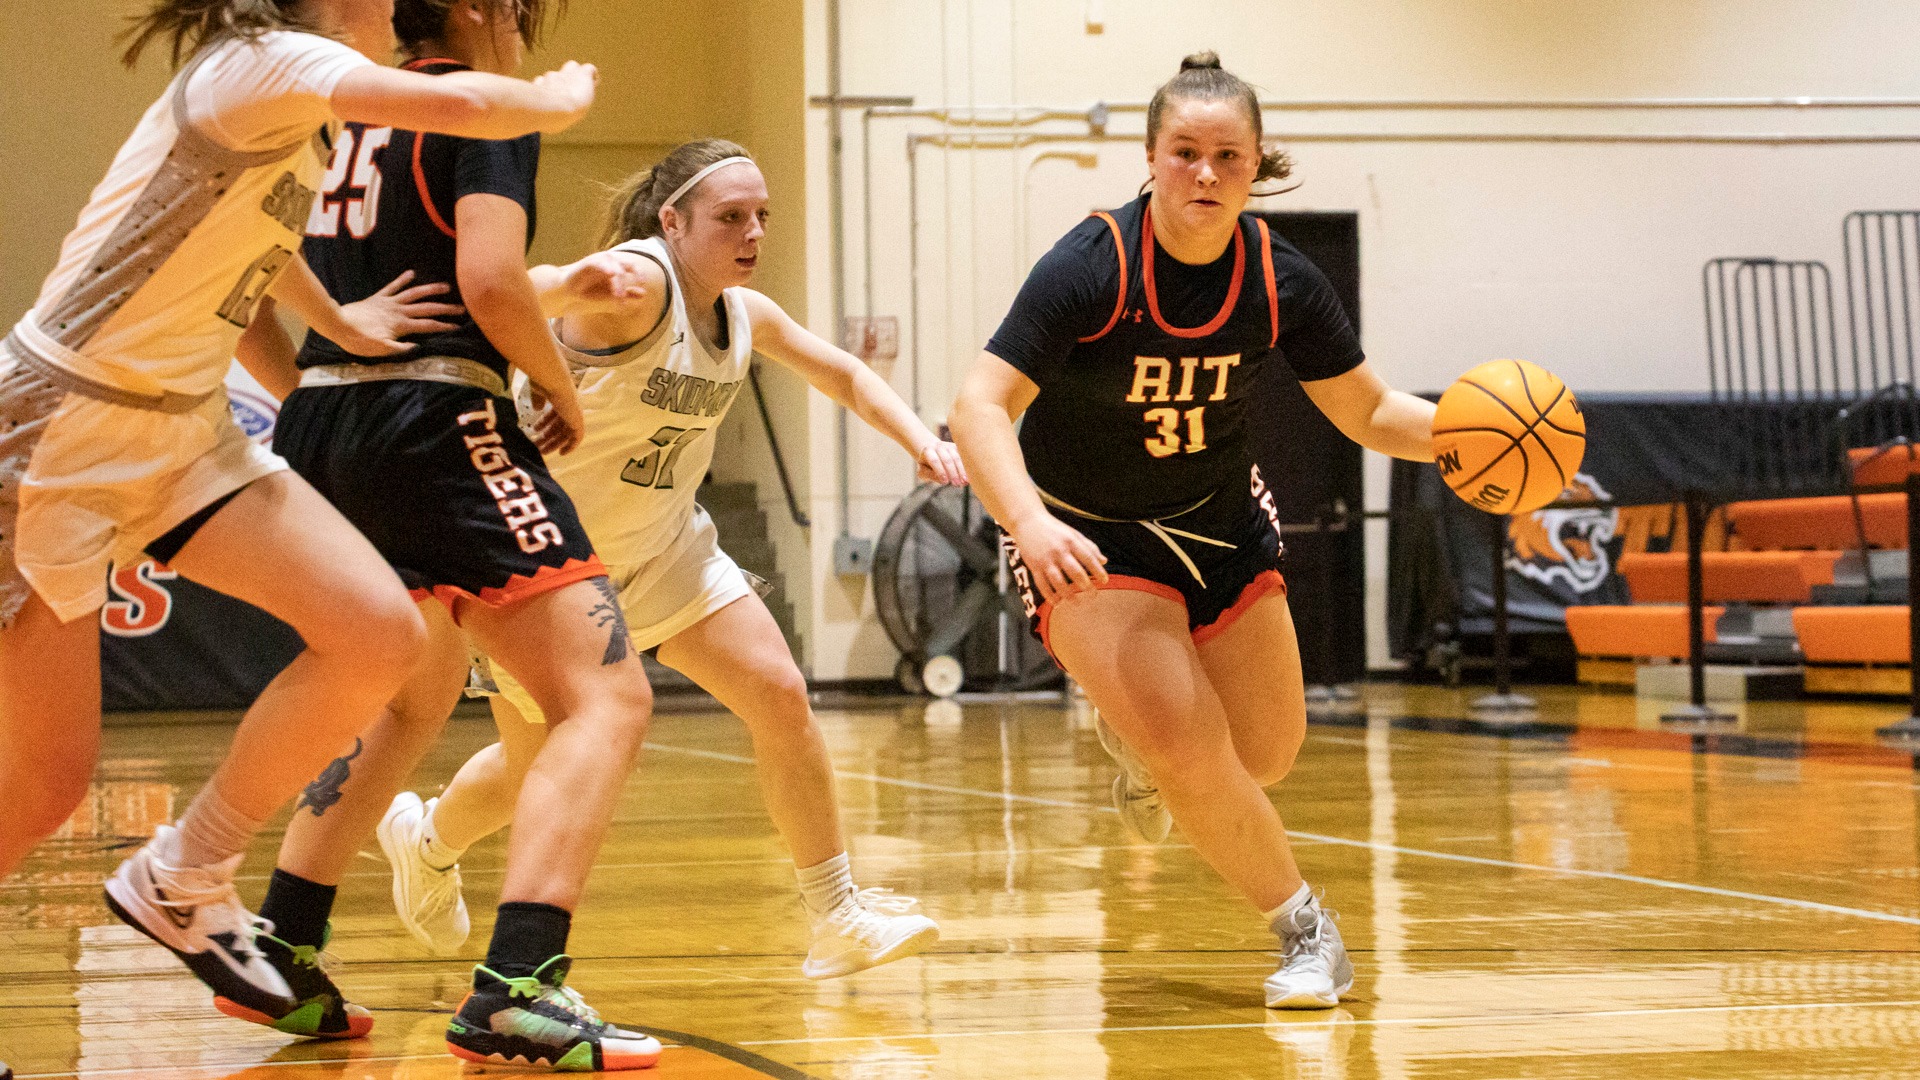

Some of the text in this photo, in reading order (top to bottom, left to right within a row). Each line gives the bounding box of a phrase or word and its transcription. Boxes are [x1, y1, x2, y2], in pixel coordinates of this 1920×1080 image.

[1125, 352, 1241, 403] RIT
[1143, 406, 1208, 458] 31
[457, 398, 564, 555] TIGERS
